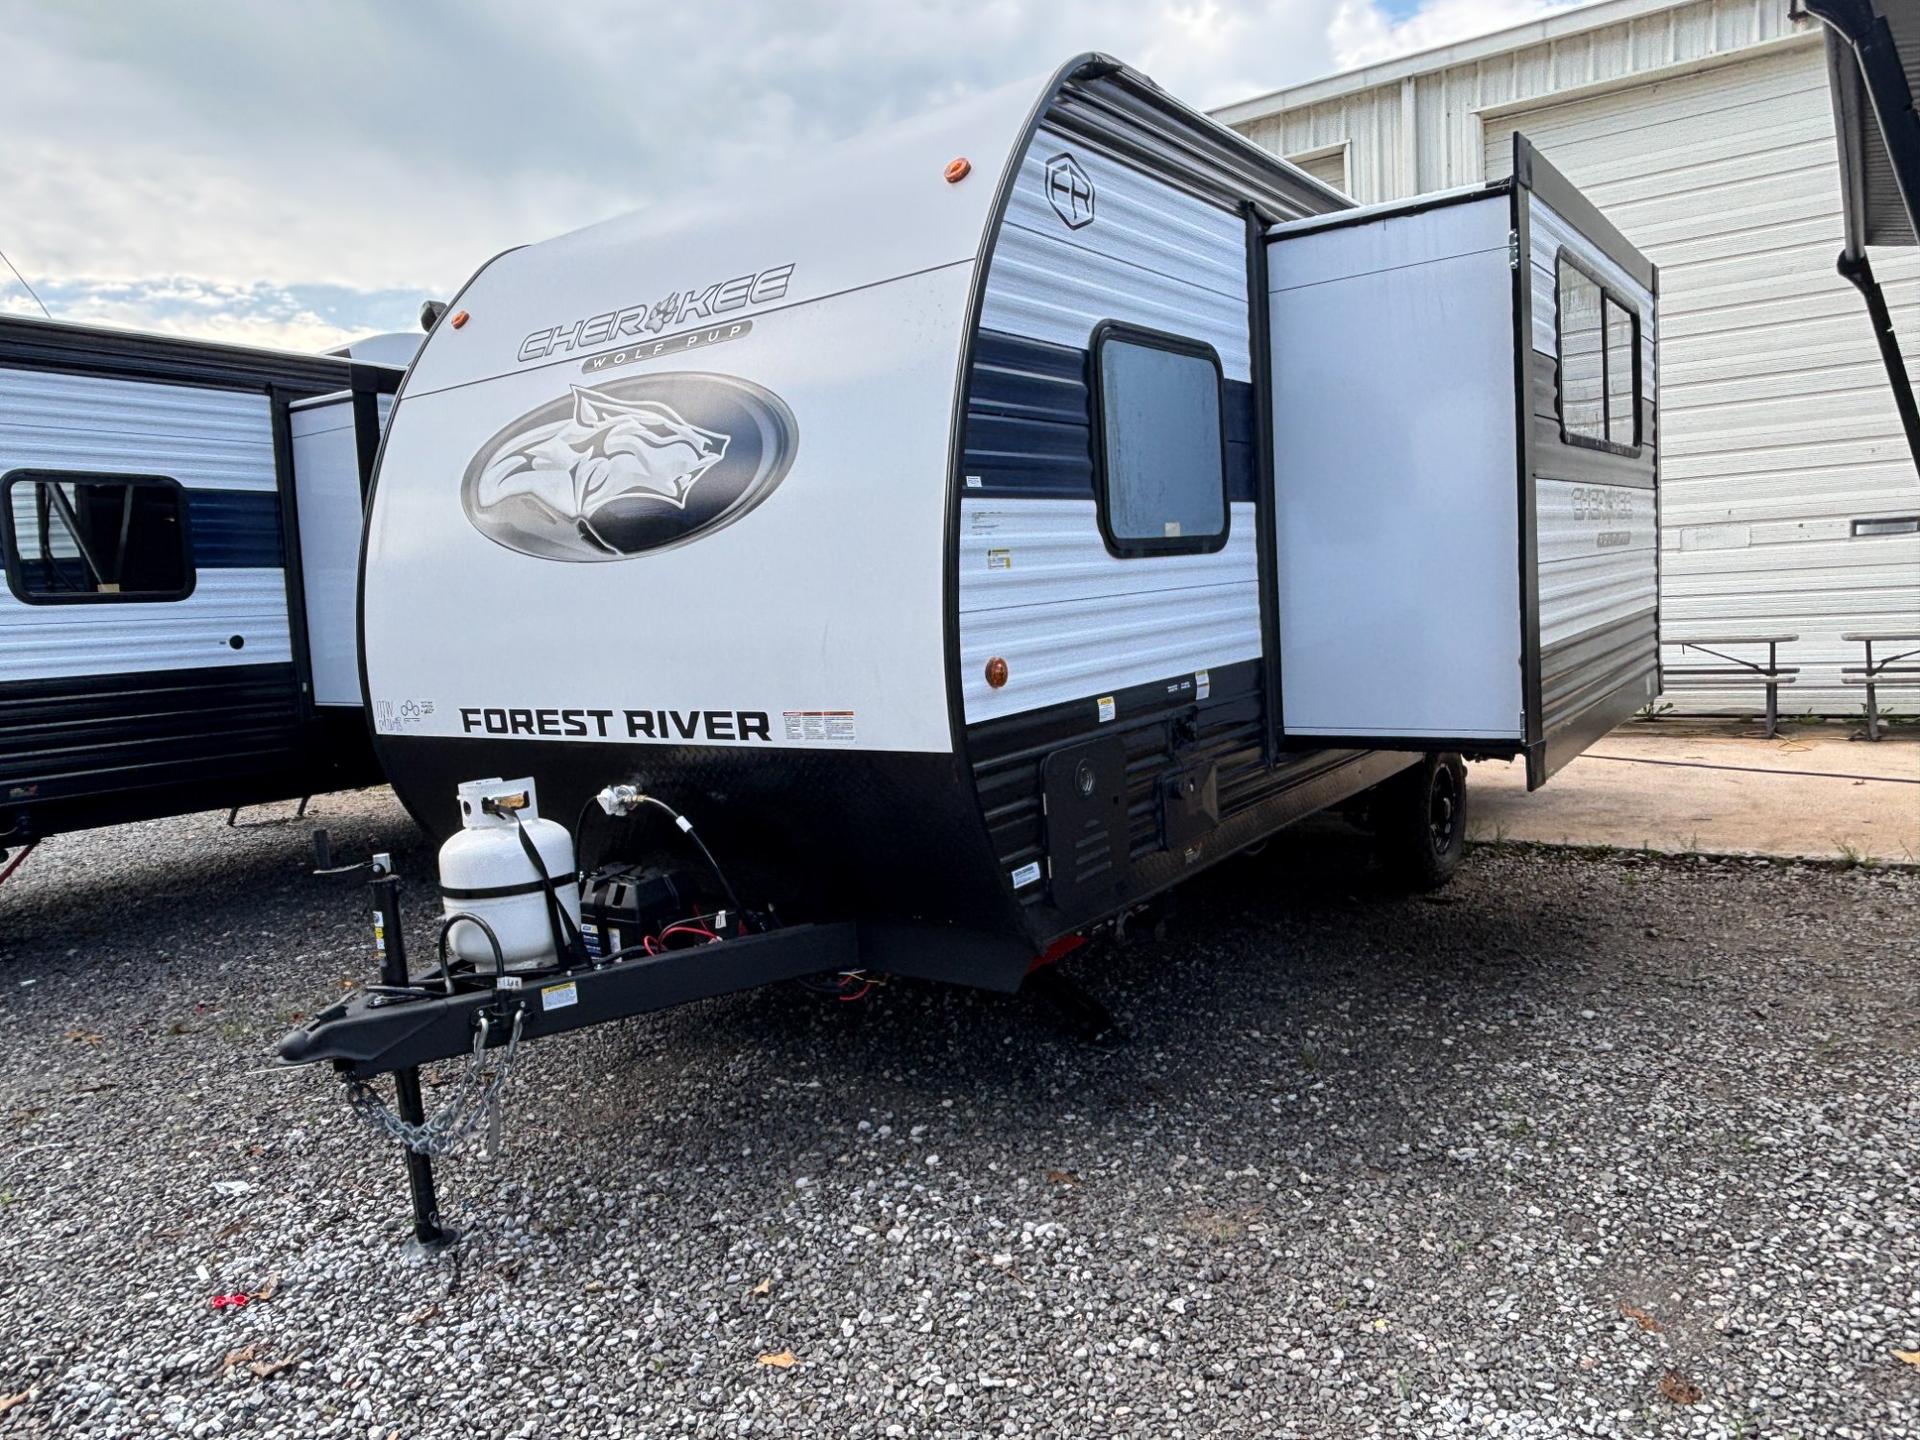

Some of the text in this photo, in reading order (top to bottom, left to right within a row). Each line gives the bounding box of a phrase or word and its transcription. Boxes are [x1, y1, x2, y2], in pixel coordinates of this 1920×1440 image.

[592, 325, 741, 368] WOLF PUP
[458, 707, 613, 738] FOREST
[622, 709, 772, 742] RIVER
